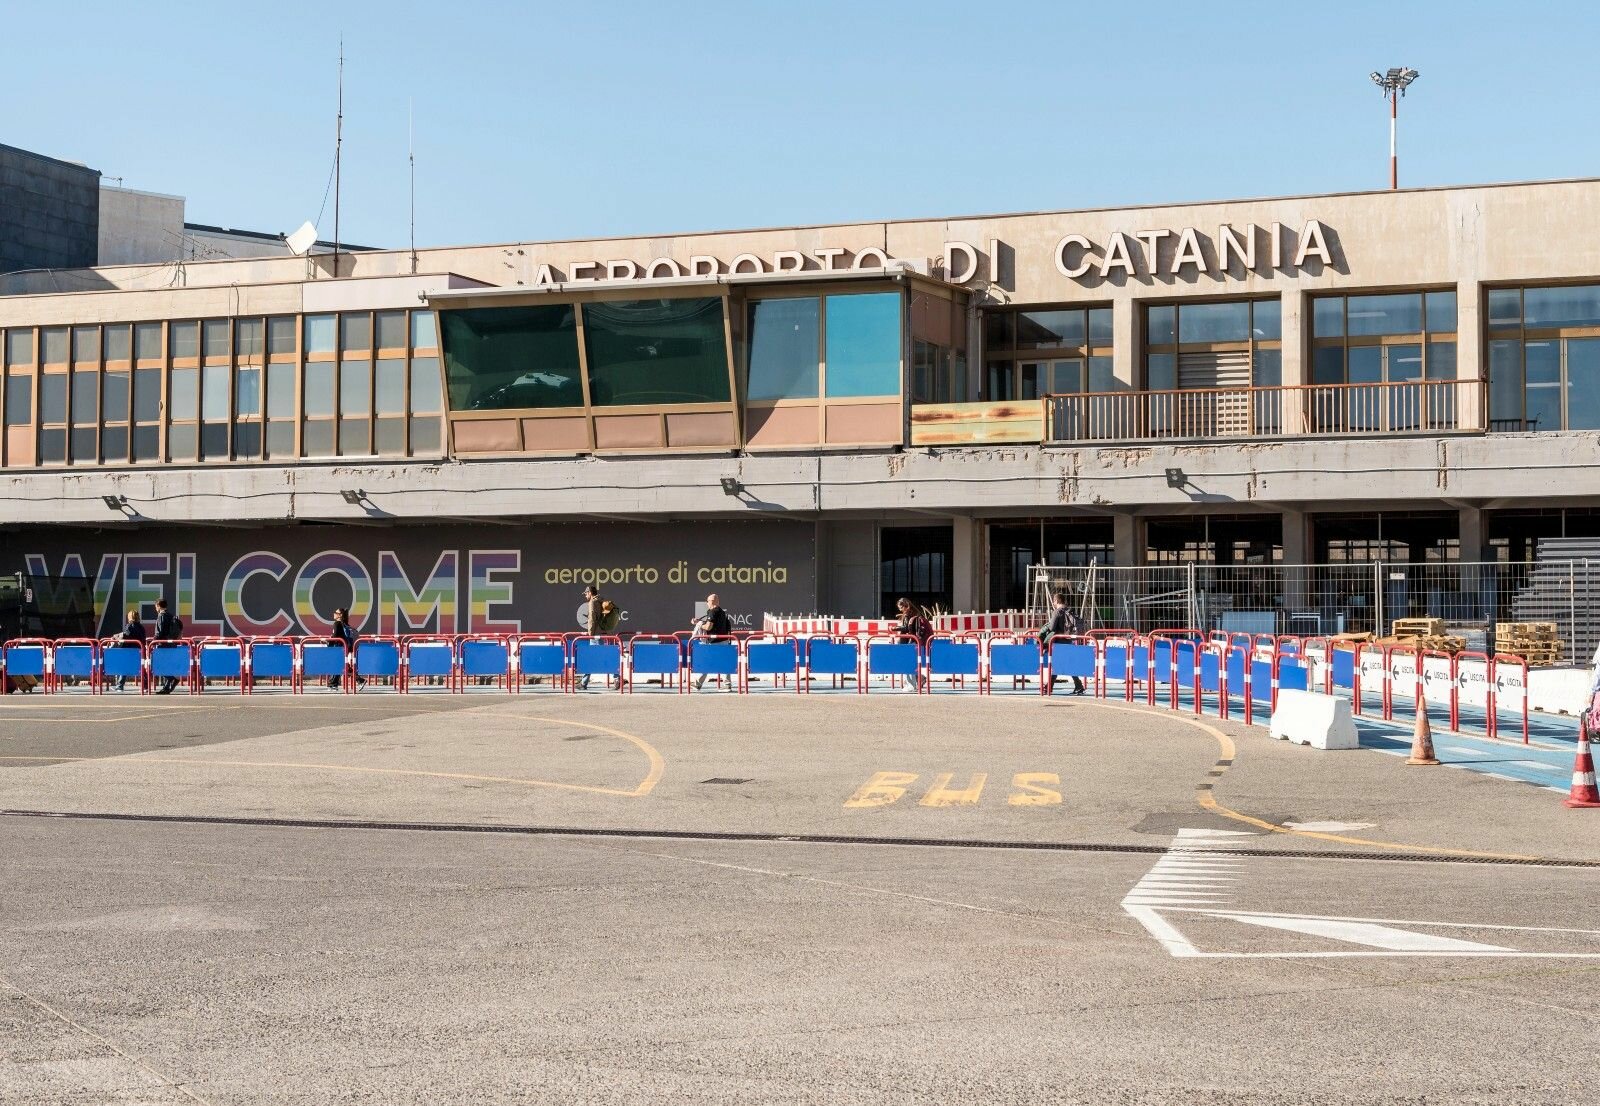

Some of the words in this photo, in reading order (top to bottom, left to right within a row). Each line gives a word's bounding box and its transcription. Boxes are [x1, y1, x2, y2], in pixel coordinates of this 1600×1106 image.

[943, 239, 999, 284] DI
[1054, 219, 1332, 279] CATANIA
[544, 563, 659, 590] aeroporto
[668, 561, 688, 584] di
[697, 561, 787, 584] catania
[25, 549, 521, 636] WELCOME
[724, 610, 753, 626] NAC
[1506, 678, 1522, 687] USCITA
